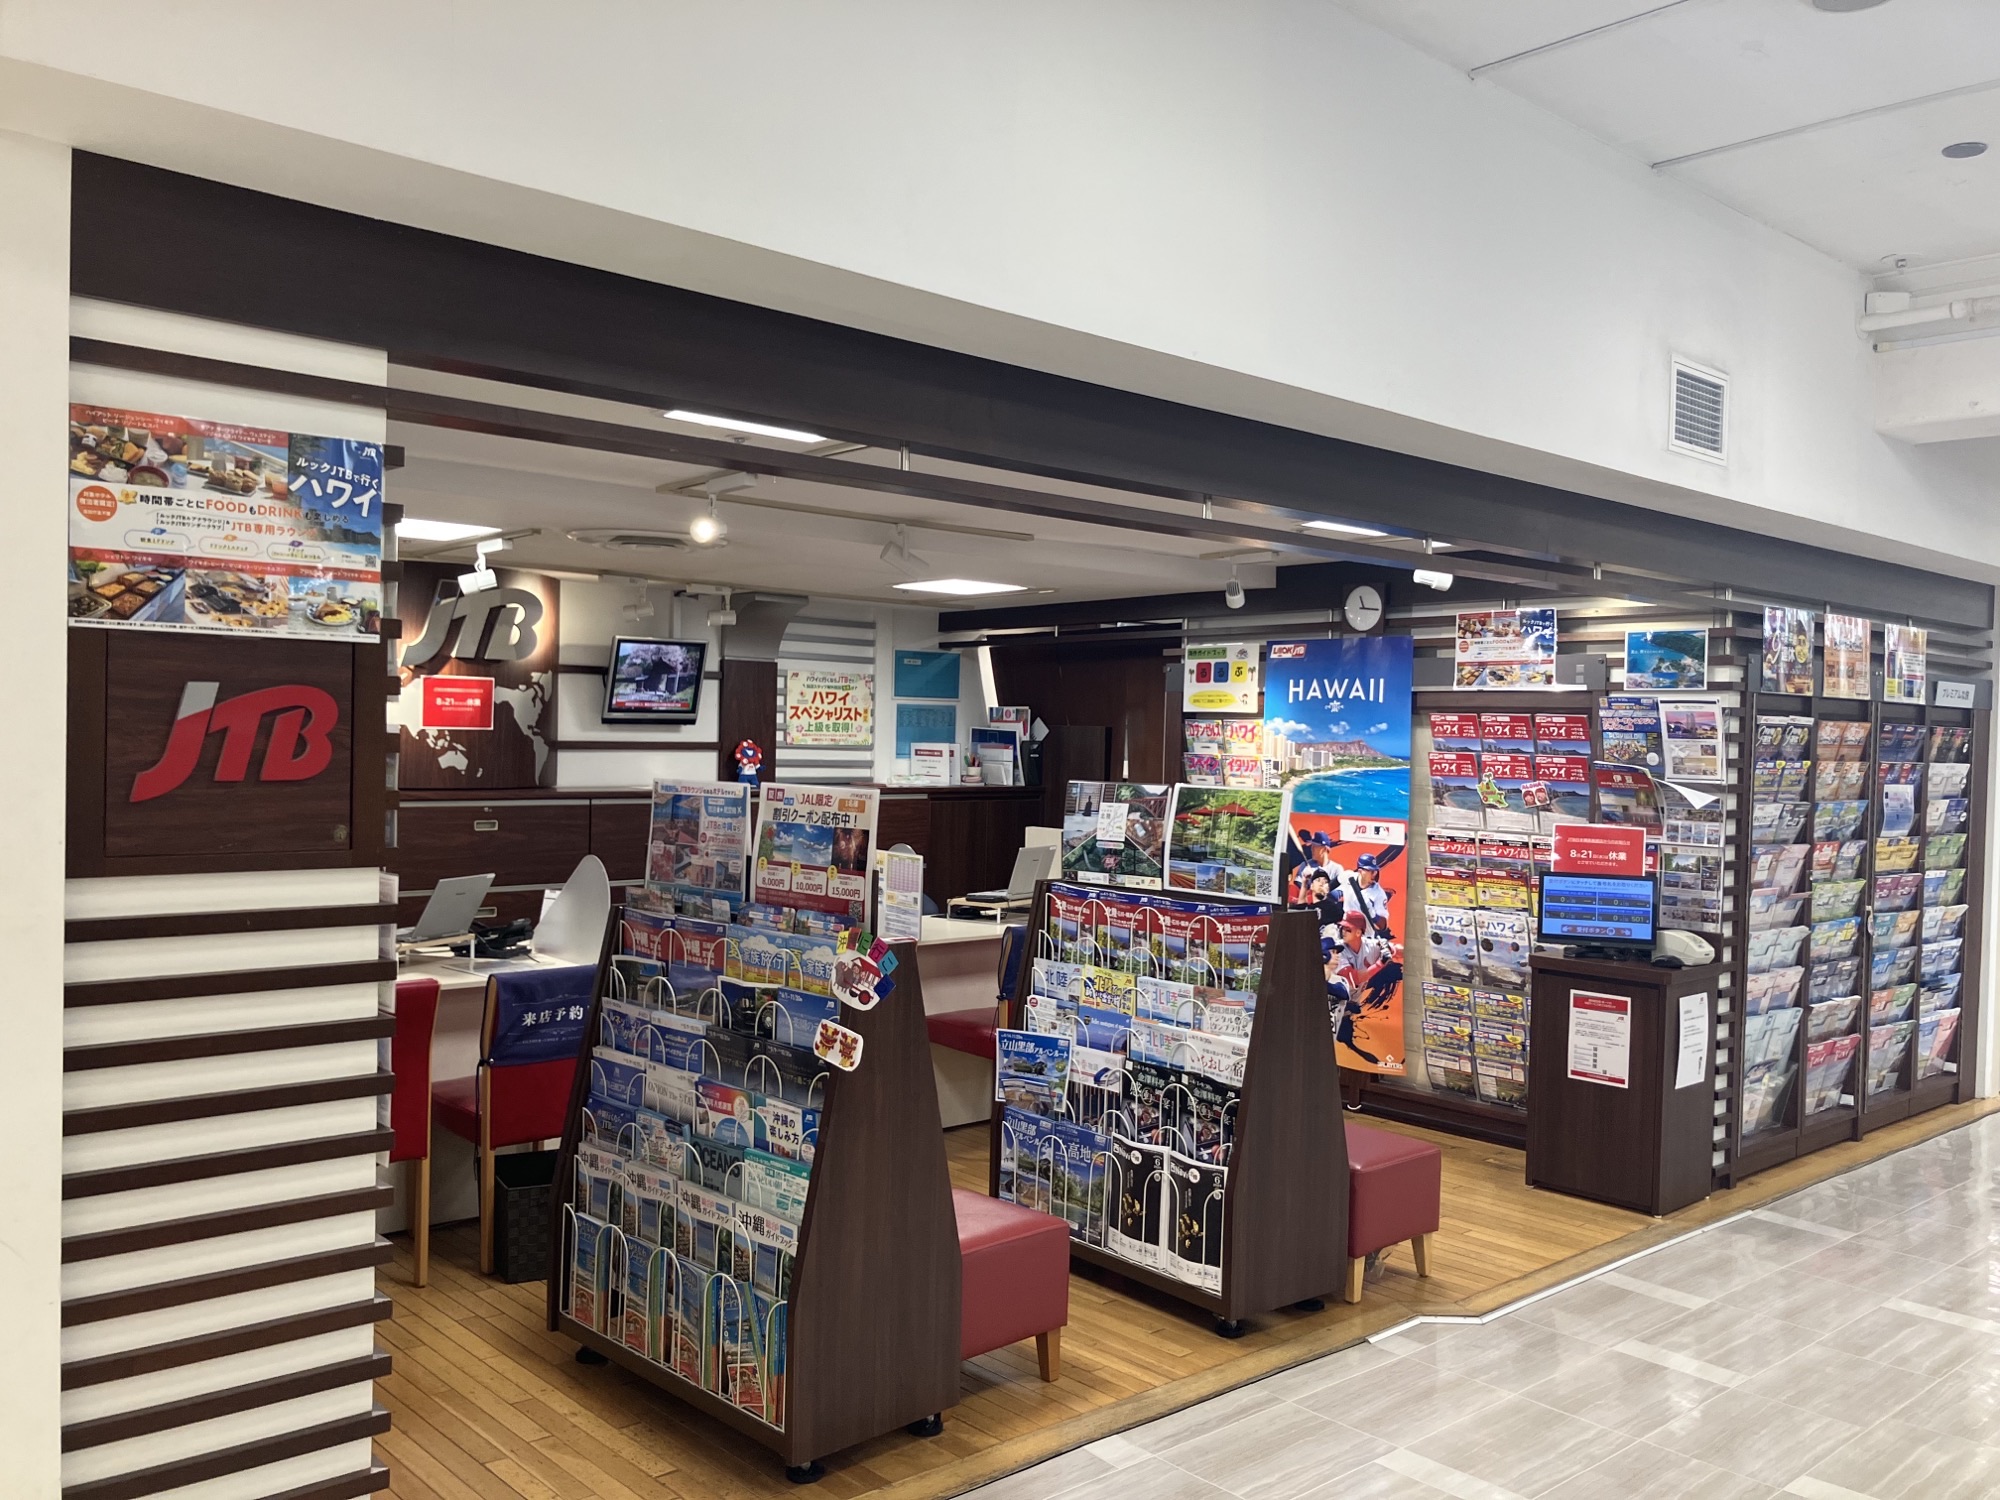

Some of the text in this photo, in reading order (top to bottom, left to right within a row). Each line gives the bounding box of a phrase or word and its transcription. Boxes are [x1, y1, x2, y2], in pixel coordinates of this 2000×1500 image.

[297, 457, 380, 489] ルックJTBで行く
[289, 474, 378, 518] ハワイ
[400, 578, 544, 668] JTB
[1288, 678, 1384, 704] HAWAII
[811, 691, 850, 706] ハワイ
[789, 705, 862, 722] スペシャリスト
[804, 721, 853, 733] 上級を取得!
[1229, 725, 1257, 739] ハワイ
[1434, 725, 1459, 734] ハワイ
[1484, 724, 1510, 736] ハワイ
[1539, 725, 1566, 736] ハワイ
[129, 680, 339, 803] JTB
[1190, 757, 1218, 770] スペイン
[1228, 758, 1258, 772] イタリア
[1432, 763, 1457, 773] ハワイ
[1539, 767, 1566, 778] ハワイ
[800, 793, 833, 808] JAL限定
[1352, 824, 1367, 836] JTB
[1497, 846, 1529, 859] ハワイ島
[762, 877, 785, 889] 8,000円
[795, 882, 822, 894] 10,000円
[832, 886, 860, 899] 15,000円
[1436, 915, 1463, 926] ハワイ
[1486, 921, 1516, 933] ハワイ
[1576, 925, 1606, 934] 受付ボタン
[1045, 969, 1068, 987] 北陸
[522, 1005, 584, 1027] 来店予約
[773, 1111, 796, 1129] 沖縄の
[1007, 1117, 1037, 1137] 立山黒部
[770, 1125, 800, 1145] 楽しみ方
[1056, 1138, 1092, 1164] 上高地
[692, 1142, 740, 1178] OCEANS
[1155, 1159, 1161, 1167] 6
[627, 1170, 647, 1191] 沖縄
[1214, 1176, 1221, 1185] 6
[681, 1191, 702, 1213] 沖縄
[738, 1210, 765, 1236] 沖縄
